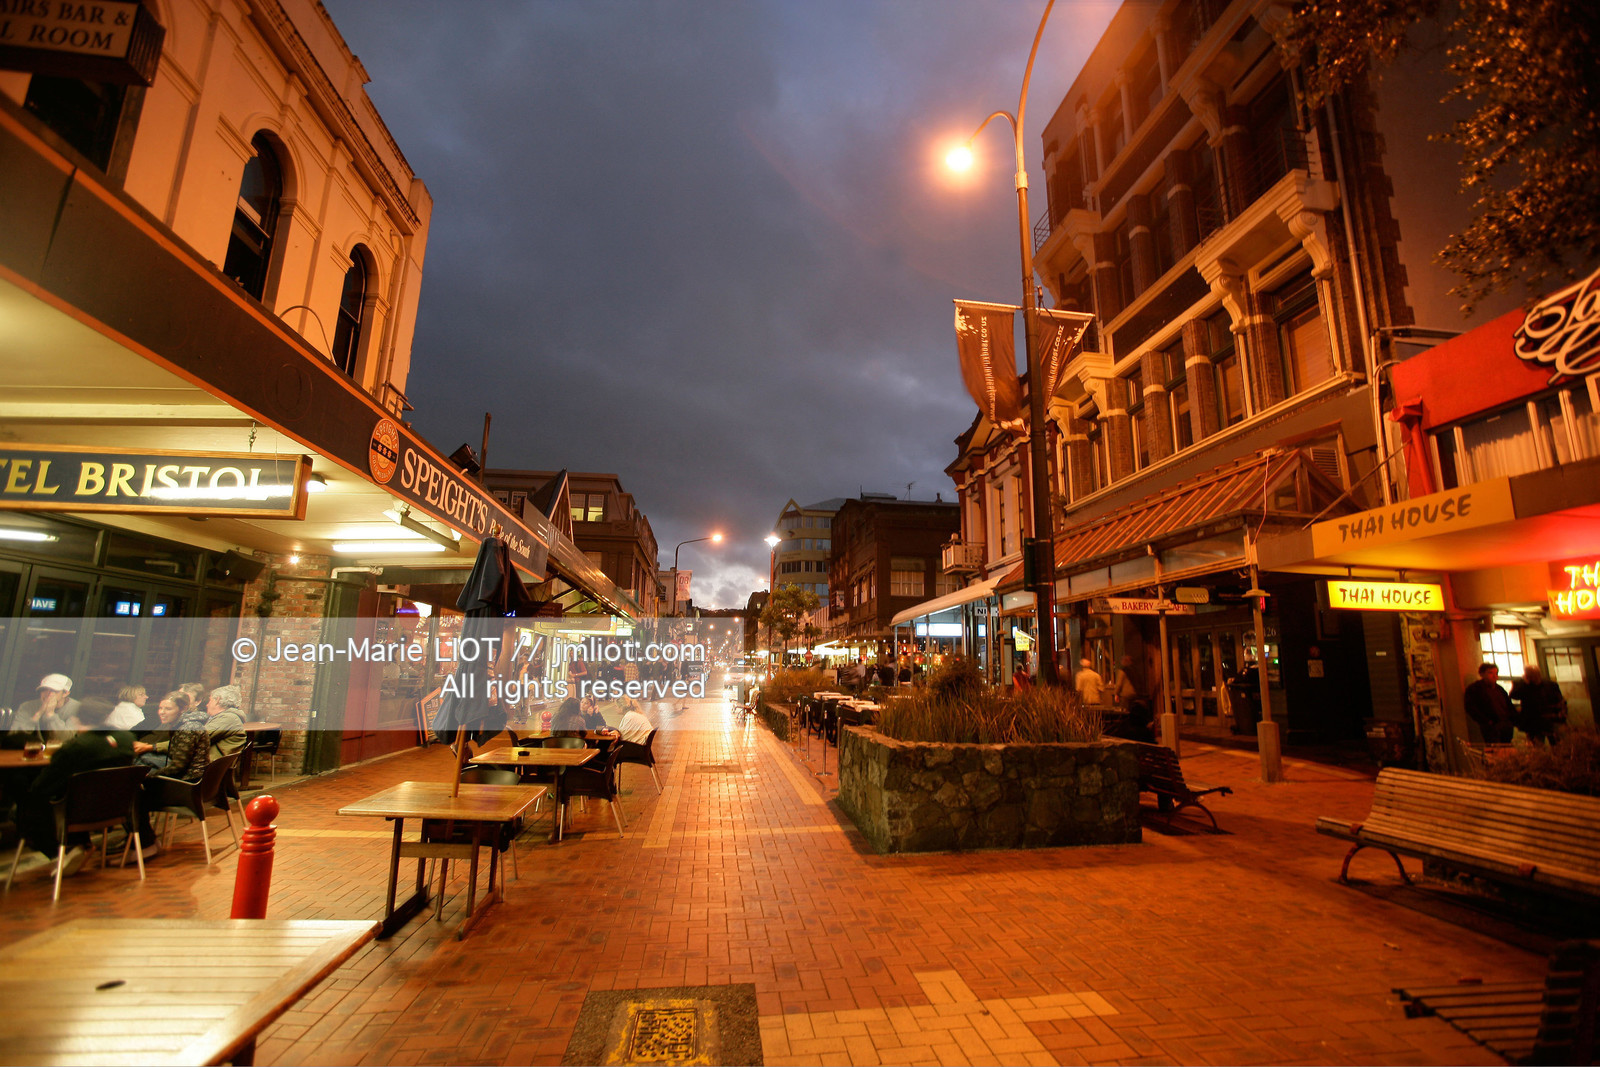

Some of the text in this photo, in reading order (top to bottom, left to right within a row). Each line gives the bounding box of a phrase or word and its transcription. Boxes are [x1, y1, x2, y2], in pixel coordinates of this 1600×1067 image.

[58, 4, 105, 24] BAR
[114, 11, 130, 26] &
[28, 24, 114, 50] ROOM
[75, 462, 270, 501] BRISTOL
[400, 448, 489, 535] SPEIGHT'S
[1338, 494, 1472, 543] THAI HOUSE
[1122, 602, 1154, 611] BAKERY
[1339, 588, 1432, 605] THAI HOUSE
